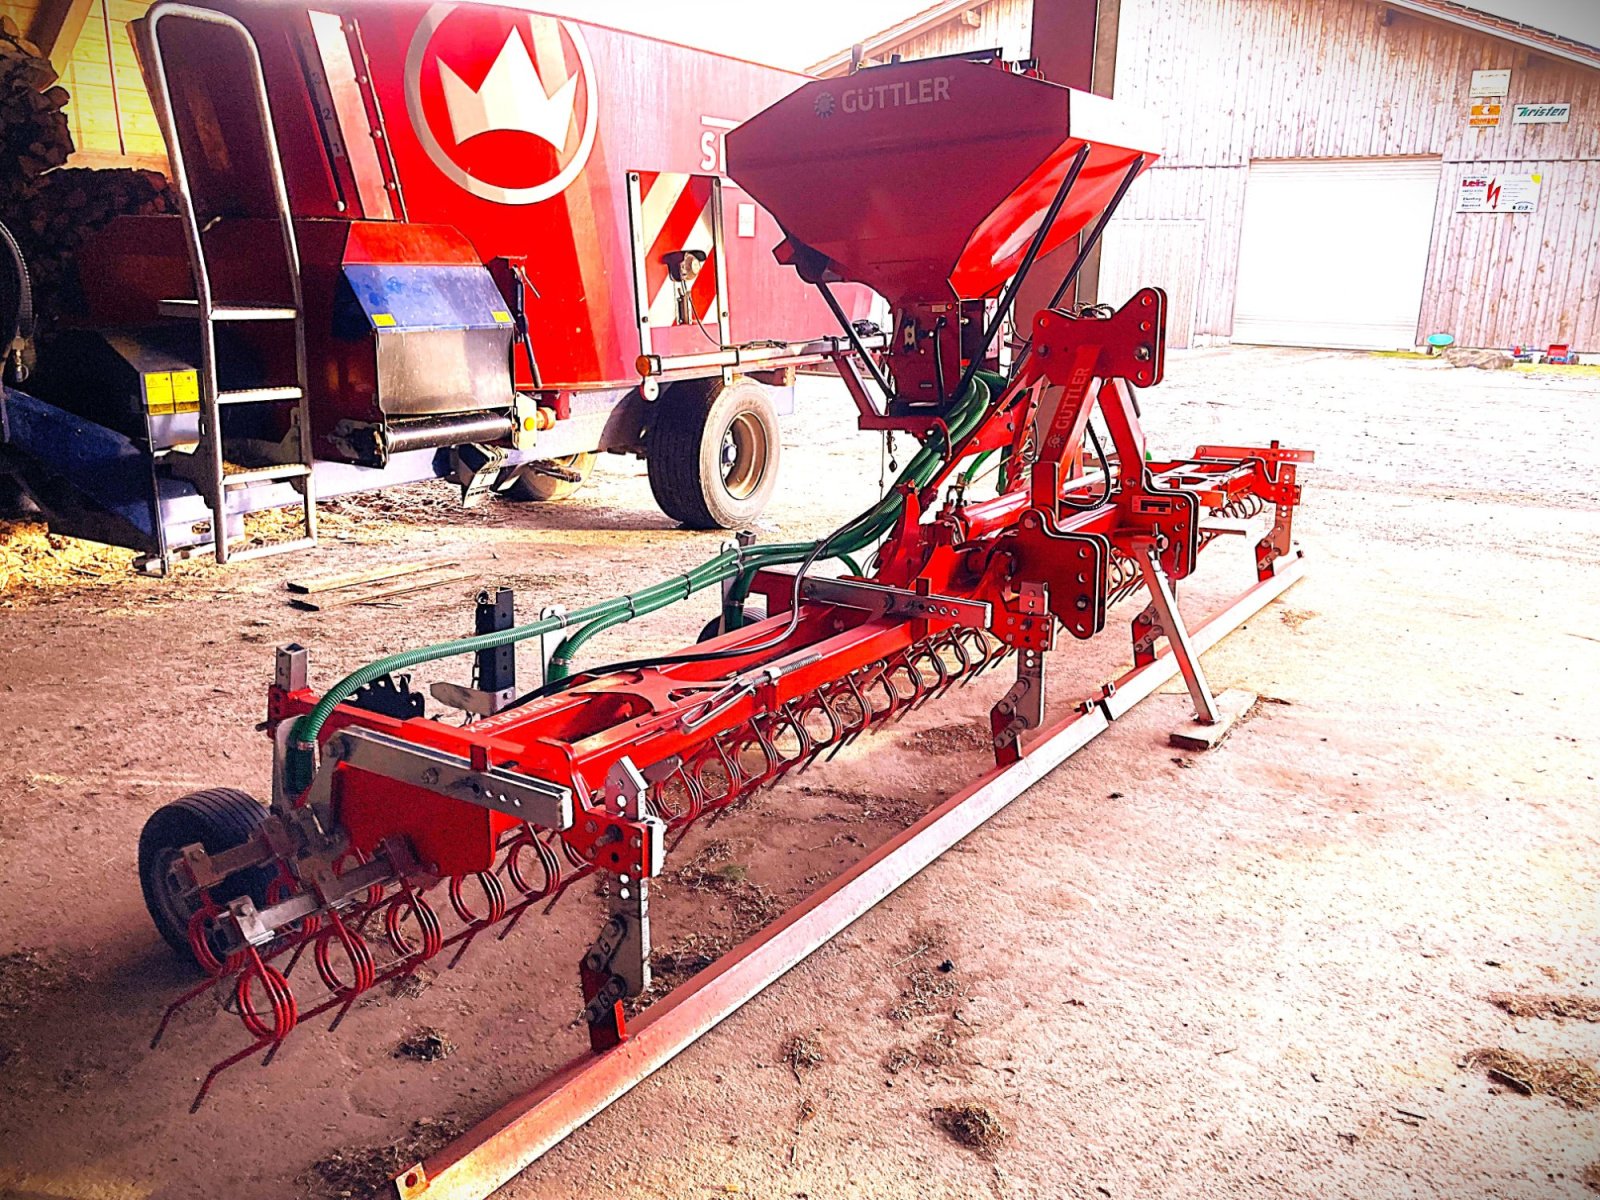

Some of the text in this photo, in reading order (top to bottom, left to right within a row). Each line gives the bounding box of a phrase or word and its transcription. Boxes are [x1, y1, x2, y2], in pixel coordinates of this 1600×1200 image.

[841, 76, 951, 114] GÜTTLER
[1516, 106, 1568, 117] Kristen
[1462, 179, 1487, 188] Leis
[1055, 367, 1090, 430] GÜTTLER
